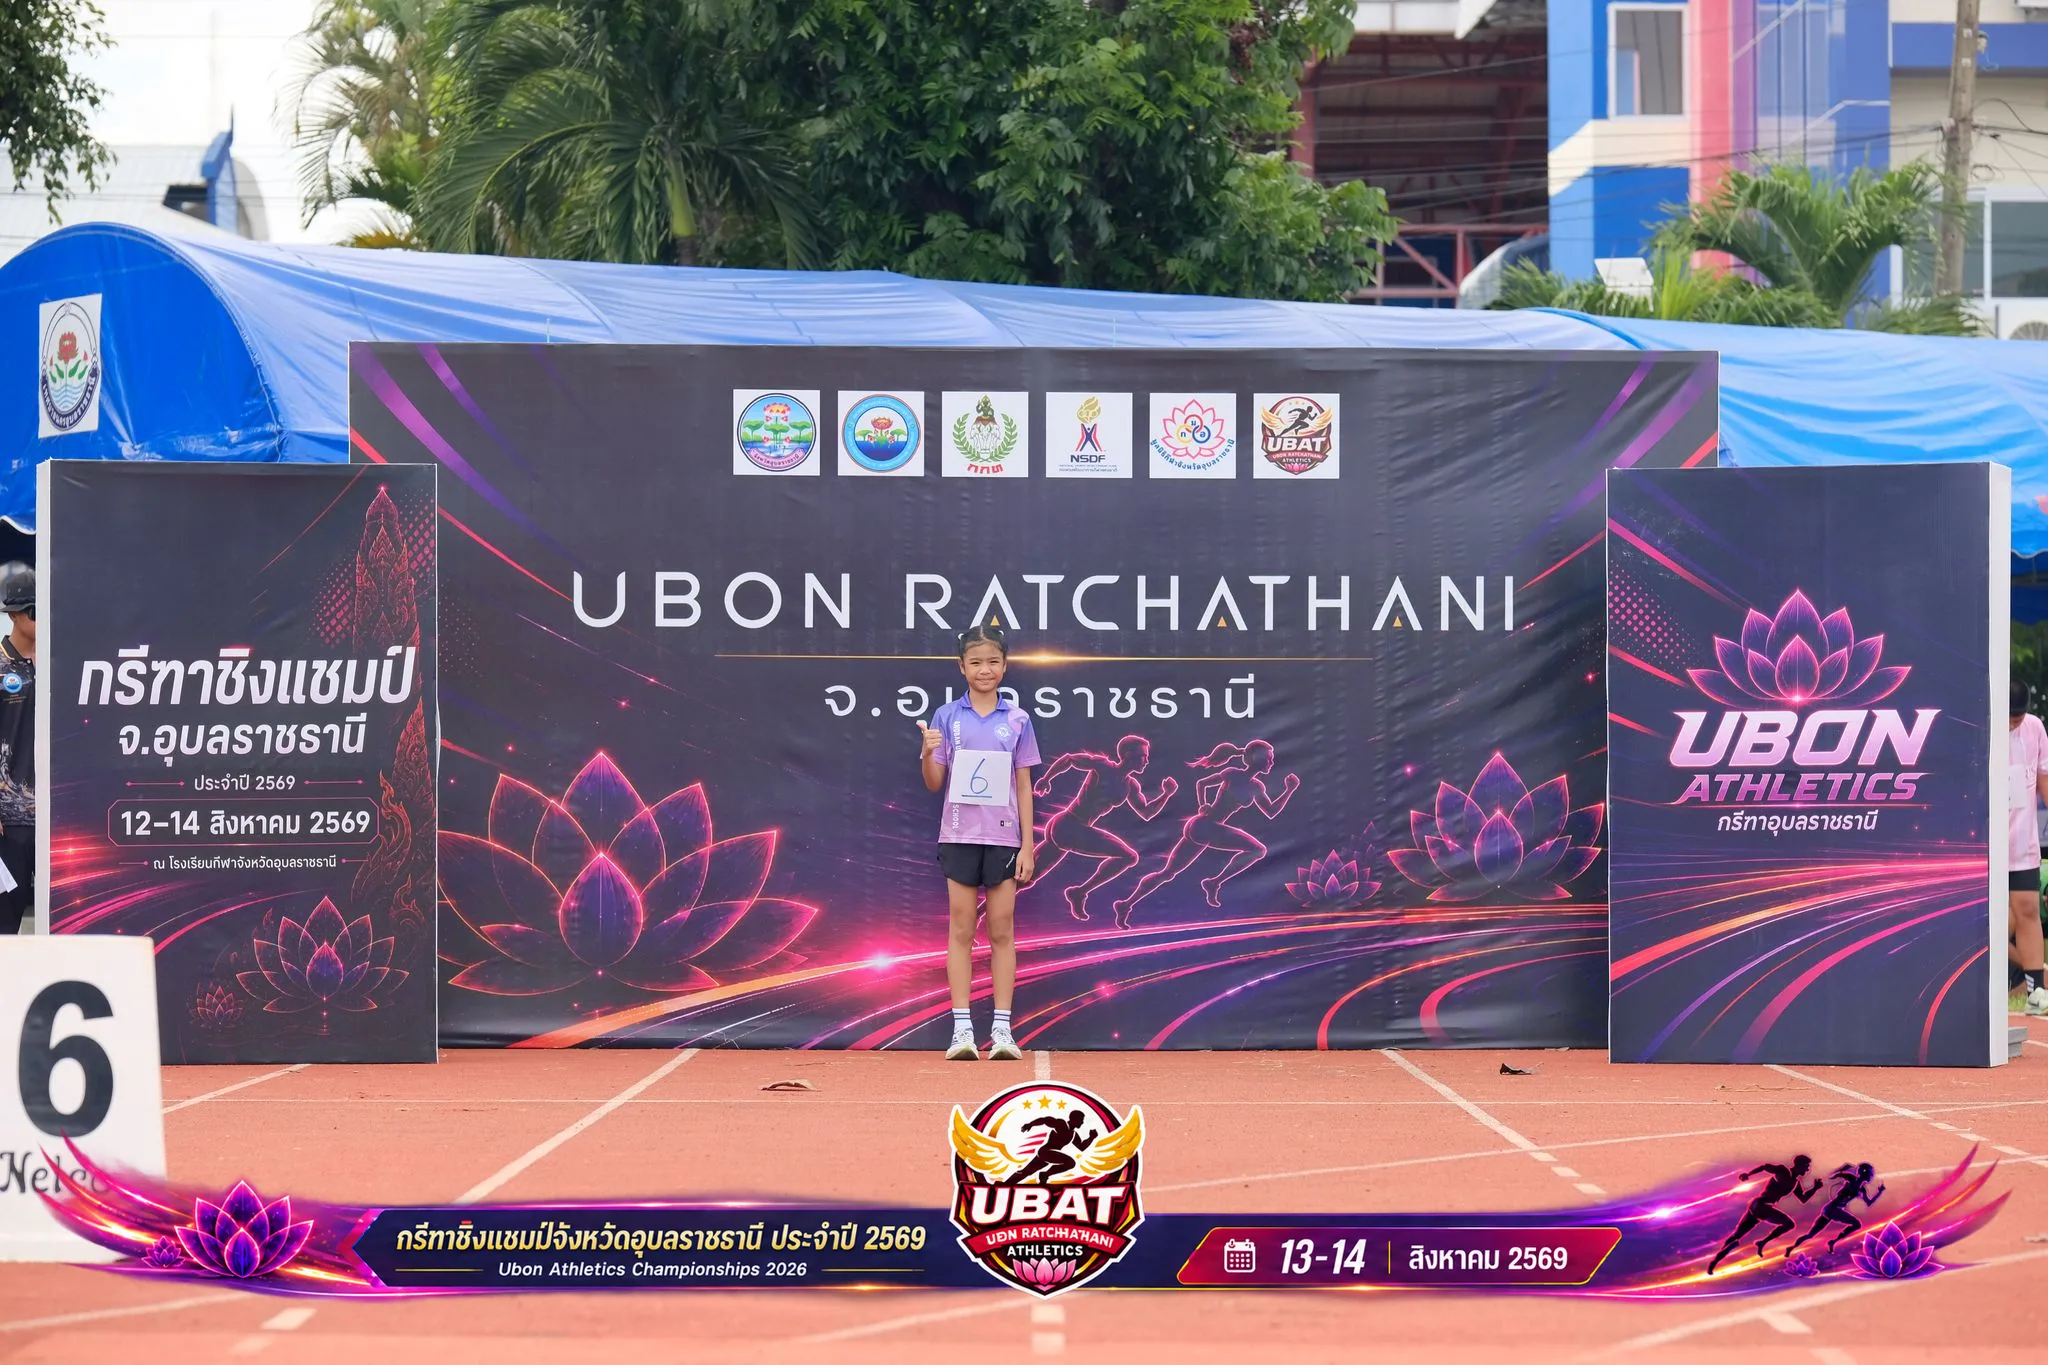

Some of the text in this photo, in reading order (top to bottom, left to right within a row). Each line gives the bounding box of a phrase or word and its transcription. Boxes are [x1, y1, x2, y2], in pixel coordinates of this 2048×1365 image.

[1070, 454, 1106, 463] NSDF
[1267, 436, 1327, 452] UBAT
[573, 571, 1514, 631] UBON RATCHATHANI
[78, 644, 416, 706] กรีฑาชิงแชมป์
[119, 712, 367, 767] จ.อุบลราชธานี
[1669, 709, 1942, 767] UBON
[194, 773, 296, 791] ประจำปี 2569
[970, 758, 988, 794] 6
[1672, 773, 1935, 804] ATHLETICS
[210, 810, 300, 835] สิงหาคม
[309, 811, 371, 834] 2569
[1717, 809, 1879, 836] กรีฑาอุบลราชธานี
[153, 854, 337, 872] ณ โรงเรียนกีฬาจังหวัดอุบลราชธานี
[18, 980, 114, 1137] 6
